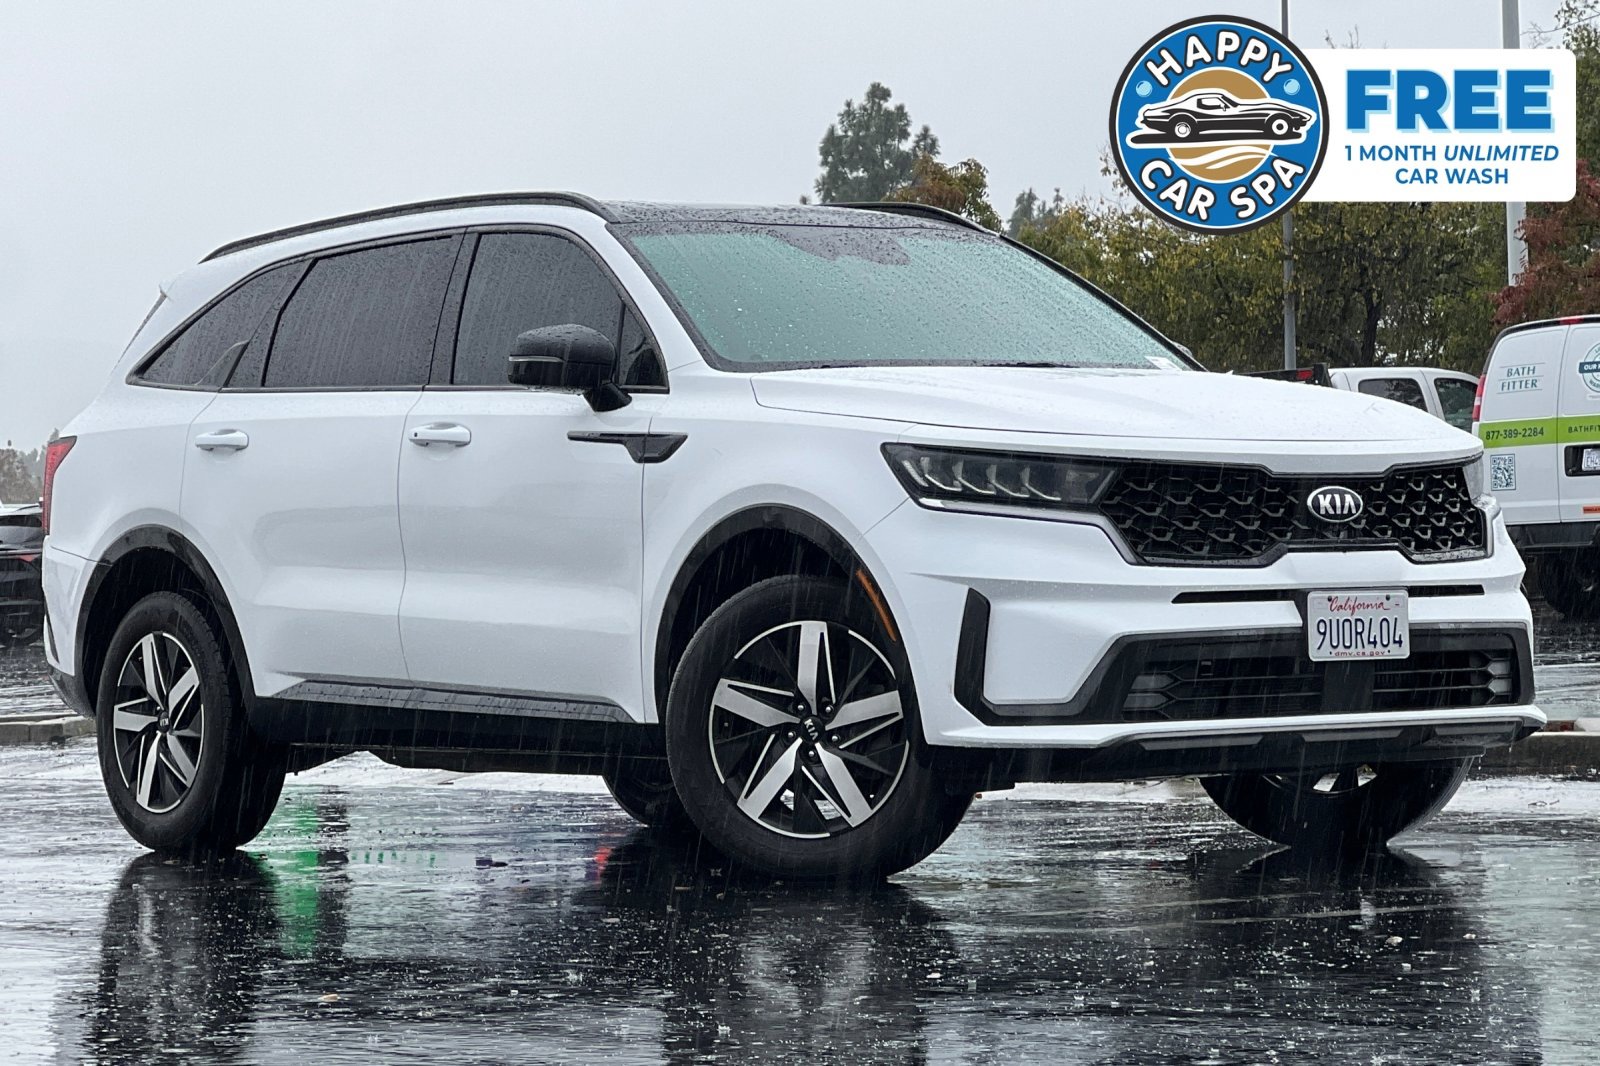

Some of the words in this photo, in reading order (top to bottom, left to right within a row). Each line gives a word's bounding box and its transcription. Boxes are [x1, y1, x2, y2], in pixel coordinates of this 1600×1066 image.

[1507, 366, 1536, 377] BATH
[1502, 379, 1538, 391] FITTER
[1486, 427, 1544, 440] 877-389-2284
[1318, 494, 1356, 515] KIA
[1329, 596, 1391, 616] California
[804, 719, 818, 740] KIA
